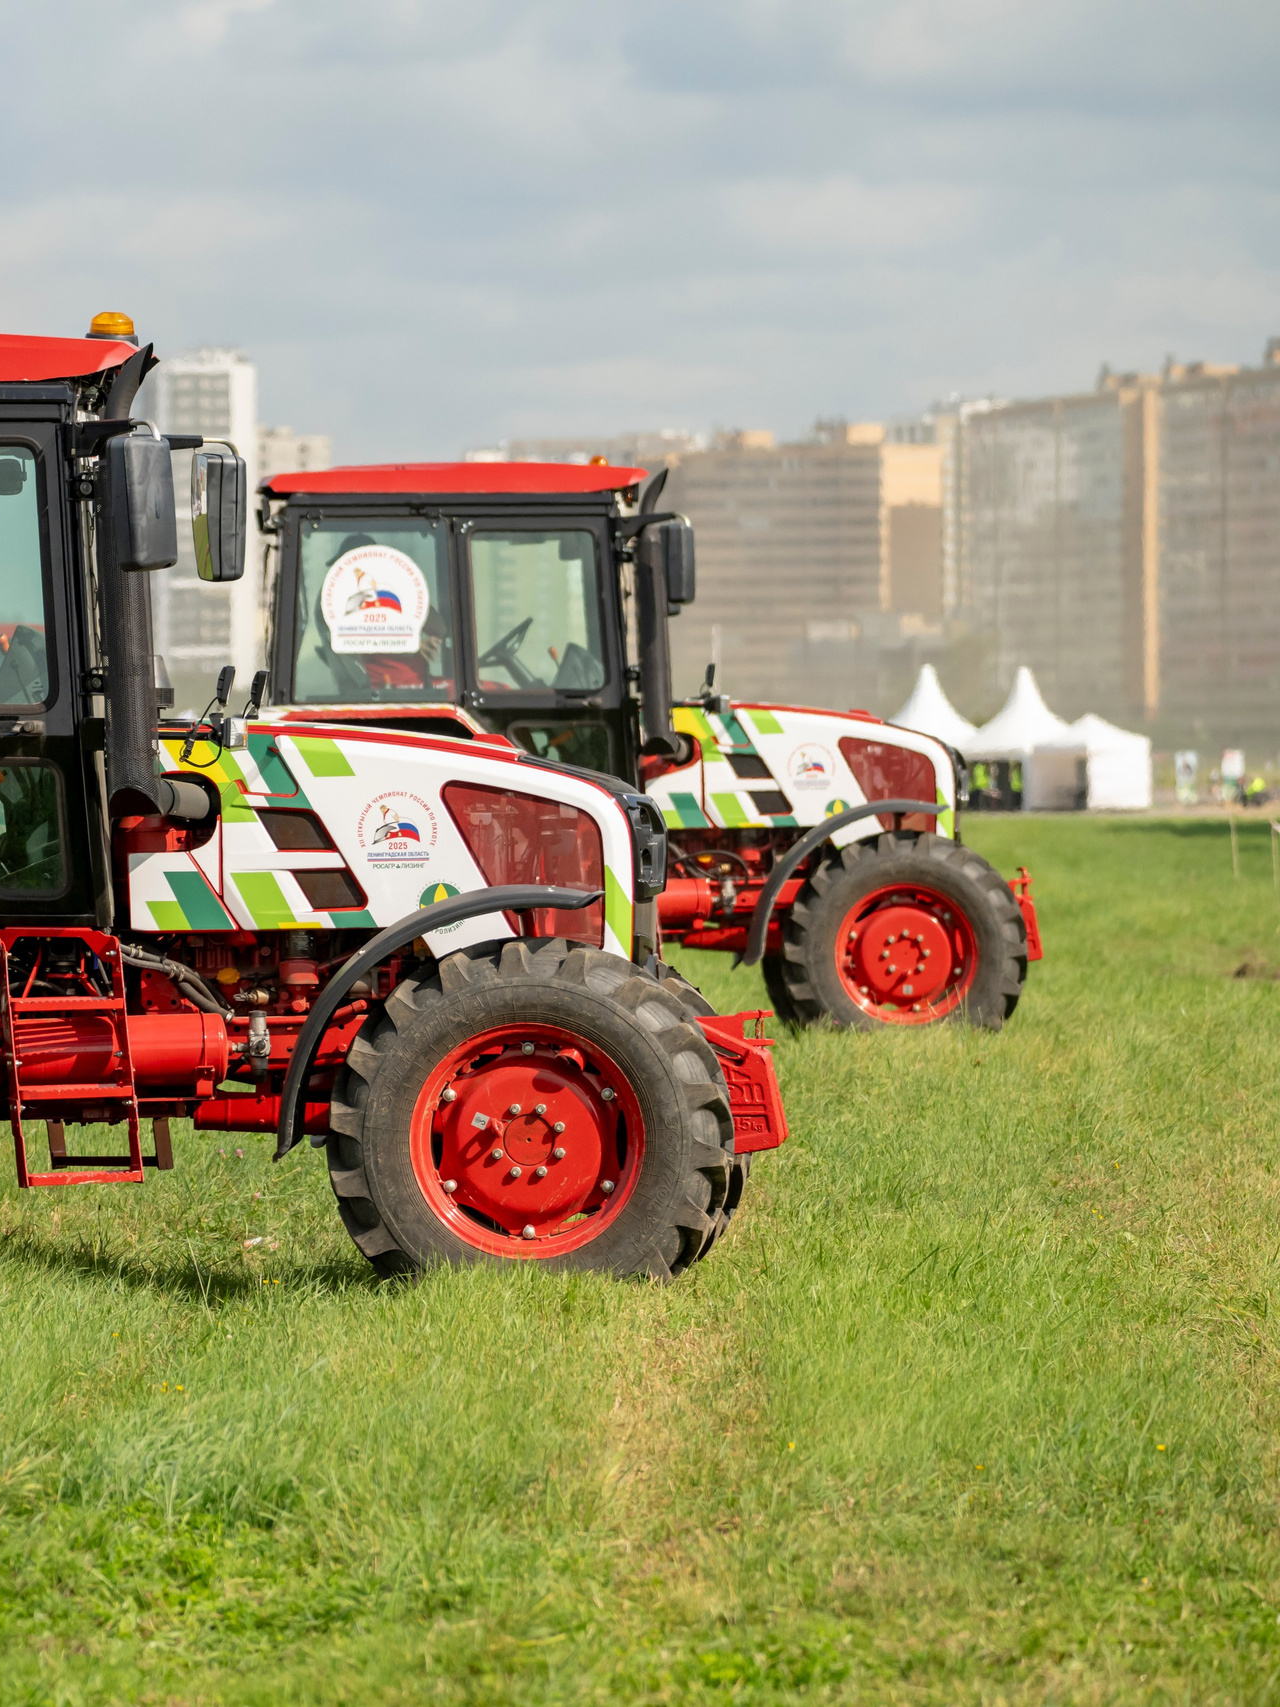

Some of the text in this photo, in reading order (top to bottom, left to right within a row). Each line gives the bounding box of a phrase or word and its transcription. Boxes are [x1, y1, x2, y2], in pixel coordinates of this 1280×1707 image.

[363, 614, 387, 623] 2025
[371, 791, 408, 804] ЧЕМПИОНАТ
[409, 794, 431, 812] РОССИИ
[357, 803, 373, 837] ОТКРЫТЫЙ
[428, 812, 436, 821] ПО
[430, 822, 438, 846] ПАХОТЕ
[388, 842, 408, 850] 2025
